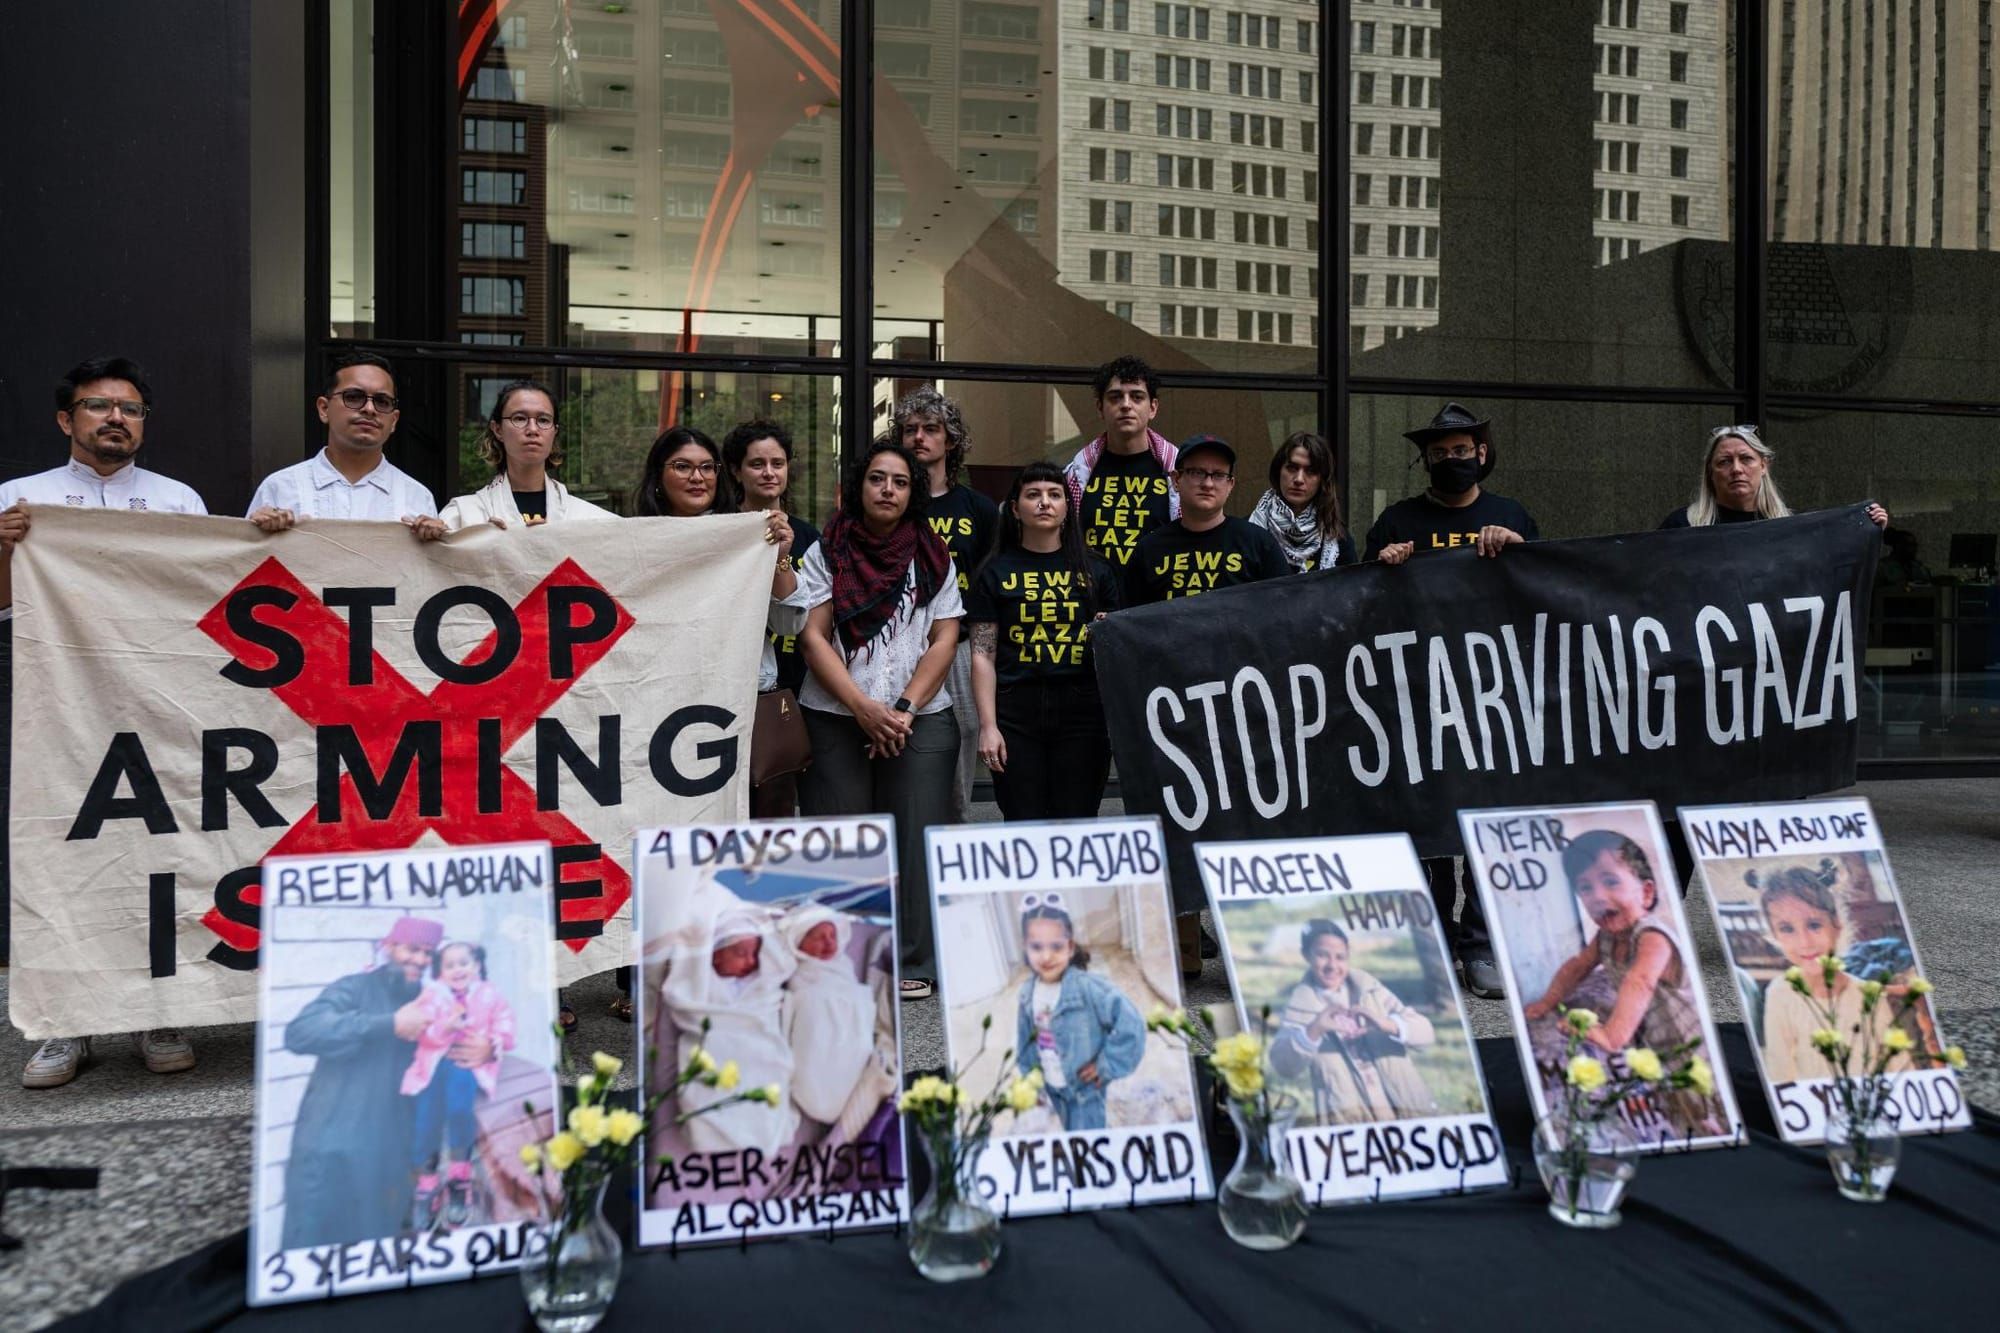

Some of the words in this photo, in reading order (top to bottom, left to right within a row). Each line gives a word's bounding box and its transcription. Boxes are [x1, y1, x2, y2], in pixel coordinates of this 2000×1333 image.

[1086, 476, 1168, 495] JEWS
[1102, 494, 1147, 508] SAY
[928, 517, 973, 536] WS
[1085, 528, 1140, 547] GAZ
[1095, 508, 1150, 528] LET
[1155, 551, 1243, 576] JEWS
[1172, 572, 1219, 589] SAY
[1020, 601, 1080, 623] LET
[1024, 586, 1072, 601] SAY
[221, 585, 618, 689] STOP
[1019, 644, 1084, 665] LIVE
[1146, 663, 1327, 832] STOP
[1345, 612, 1677, 788] STARVING
[1695, 590, 1859, 746] GAZA
[65, 704, 739, 841] ARMING
[650, 830, 674, 870] 4
[690, 828, 796, 868] DAYS
[802, 823, 887, 862] OLD
[936, 837, 1039, 882] HIND
[1050, 829, 1161, 882] RAJAB
[1487, 818, 1574, 853] YEAR
[1691, 817, 1778, 859] NAYA
[1779, 816, 1827, 845] ABU
[407, 854, 543, 898] NABHAN
[1203, 852, 1352, 896] YAQEEN
[1489, 857, 1547, 891] OLD
[1774, 1082, 1811, 1132] 5
[1903, 1075, 1961, 1122] OLD
[651, 1147, 772, 1194] ASER
[790, 1140, 907, 1188] AYSEL
[1003, 1135, 1117, 1197] YEARS
[1121, 1131, 1194, 1184] OLD
[1313, 1125, 1436, 1180] YEARS
[1437, 1122, 1500, 1171] OLD
[263, 1251, 297, 1294] 3
[307, 1231, 455, 1288] YEARS
